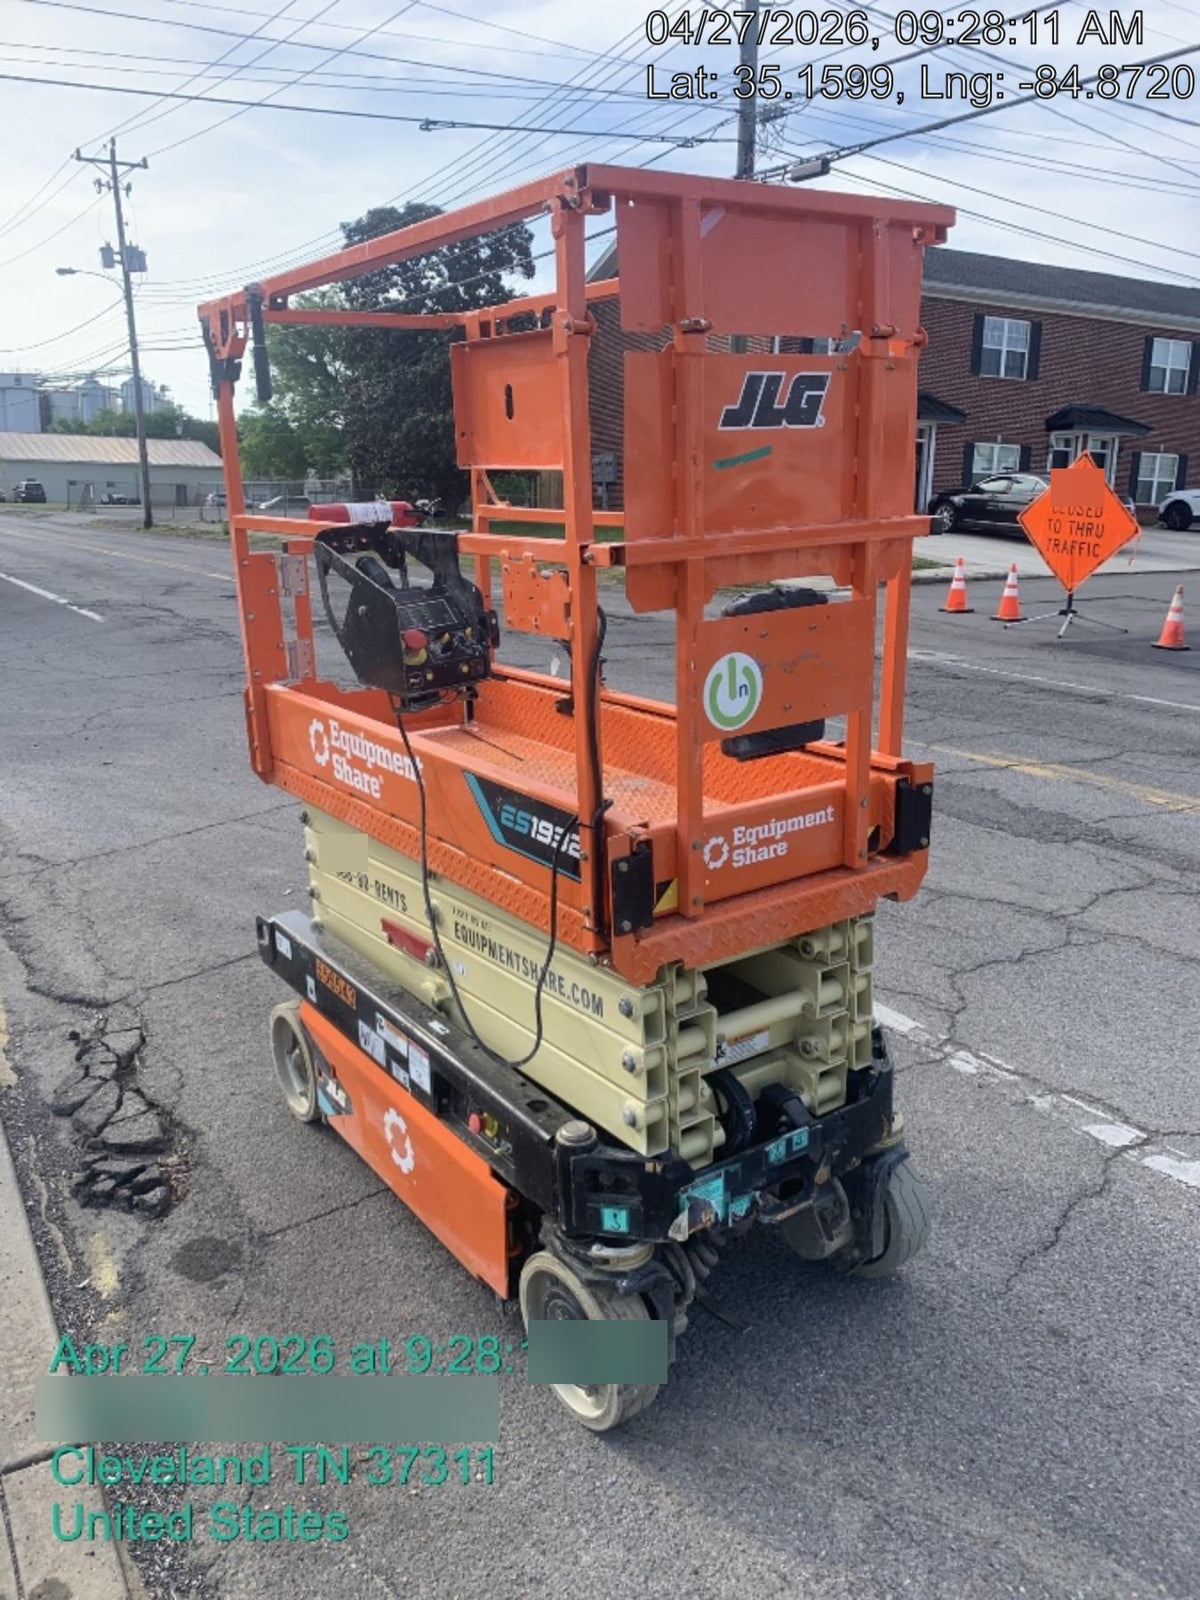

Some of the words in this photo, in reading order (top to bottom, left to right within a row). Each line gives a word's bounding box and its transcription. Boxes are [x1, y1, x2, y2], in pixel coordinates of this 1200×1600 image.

[718, 371, 832, 430] JLG
[1047, 518, 1062, 534] TO
[1068, 520, 1105, 539] THRU
[1046, 538, 1101, 558] TRAFFIC
[733, 805, 835, 846] Equipment
[732, 841, 788, 868] Share
